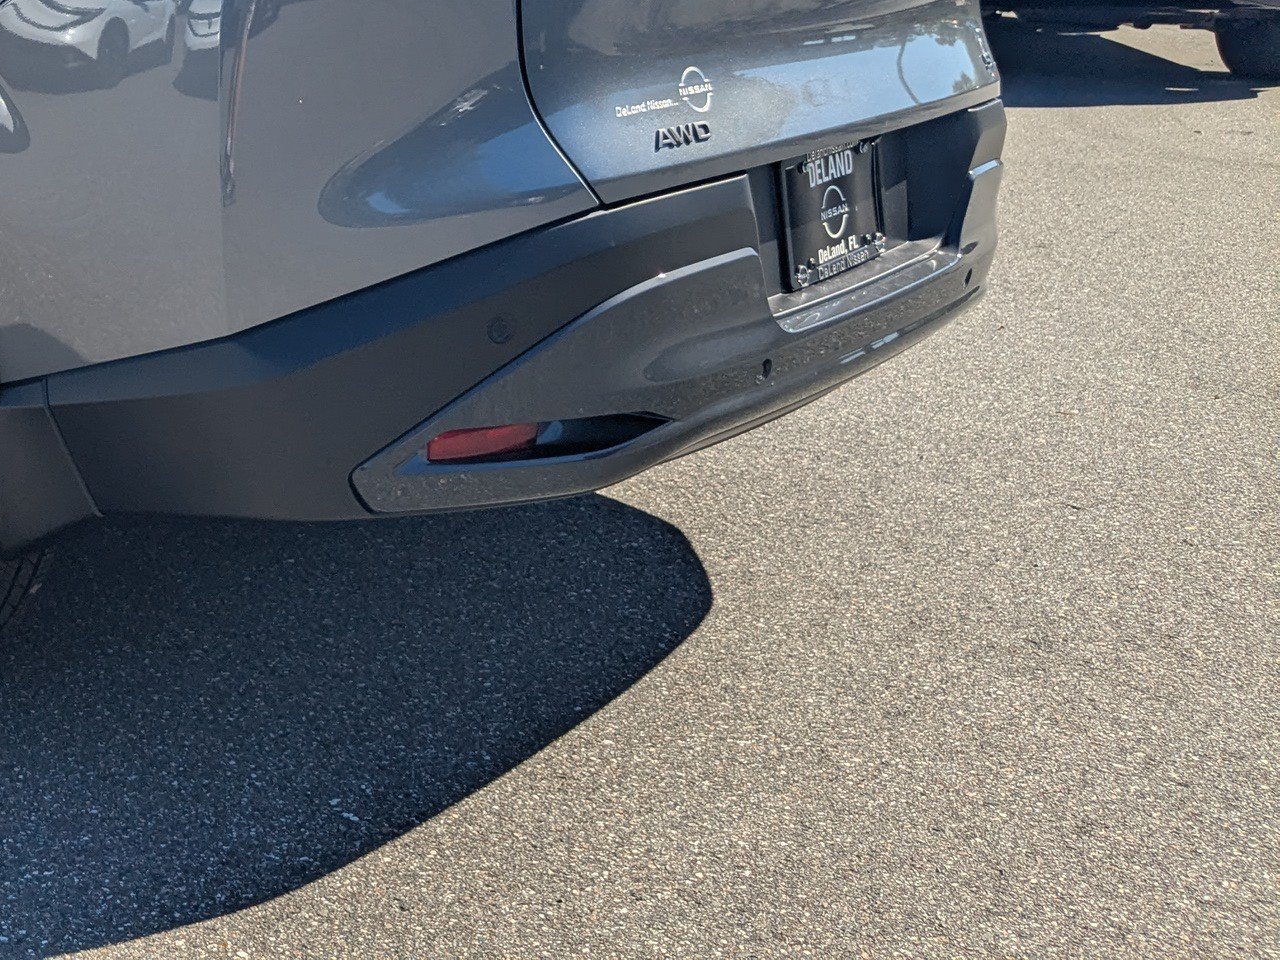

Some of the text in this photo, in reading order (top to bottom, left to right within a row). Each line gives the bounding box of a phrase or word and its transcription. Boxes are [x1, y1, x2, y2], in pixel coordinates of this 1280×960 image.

[678, 82, 714, 96] NISSAN
[615, 102, 648, 118] DeLand
[654, 120, 712, 153] AWD
[808, 149, 854, 188] DELAND
[820, 201, 850, 221] NISSAN
[817, 234, 859, 264] DeLand, FL
[846, 249, 870, 269] Nissan
